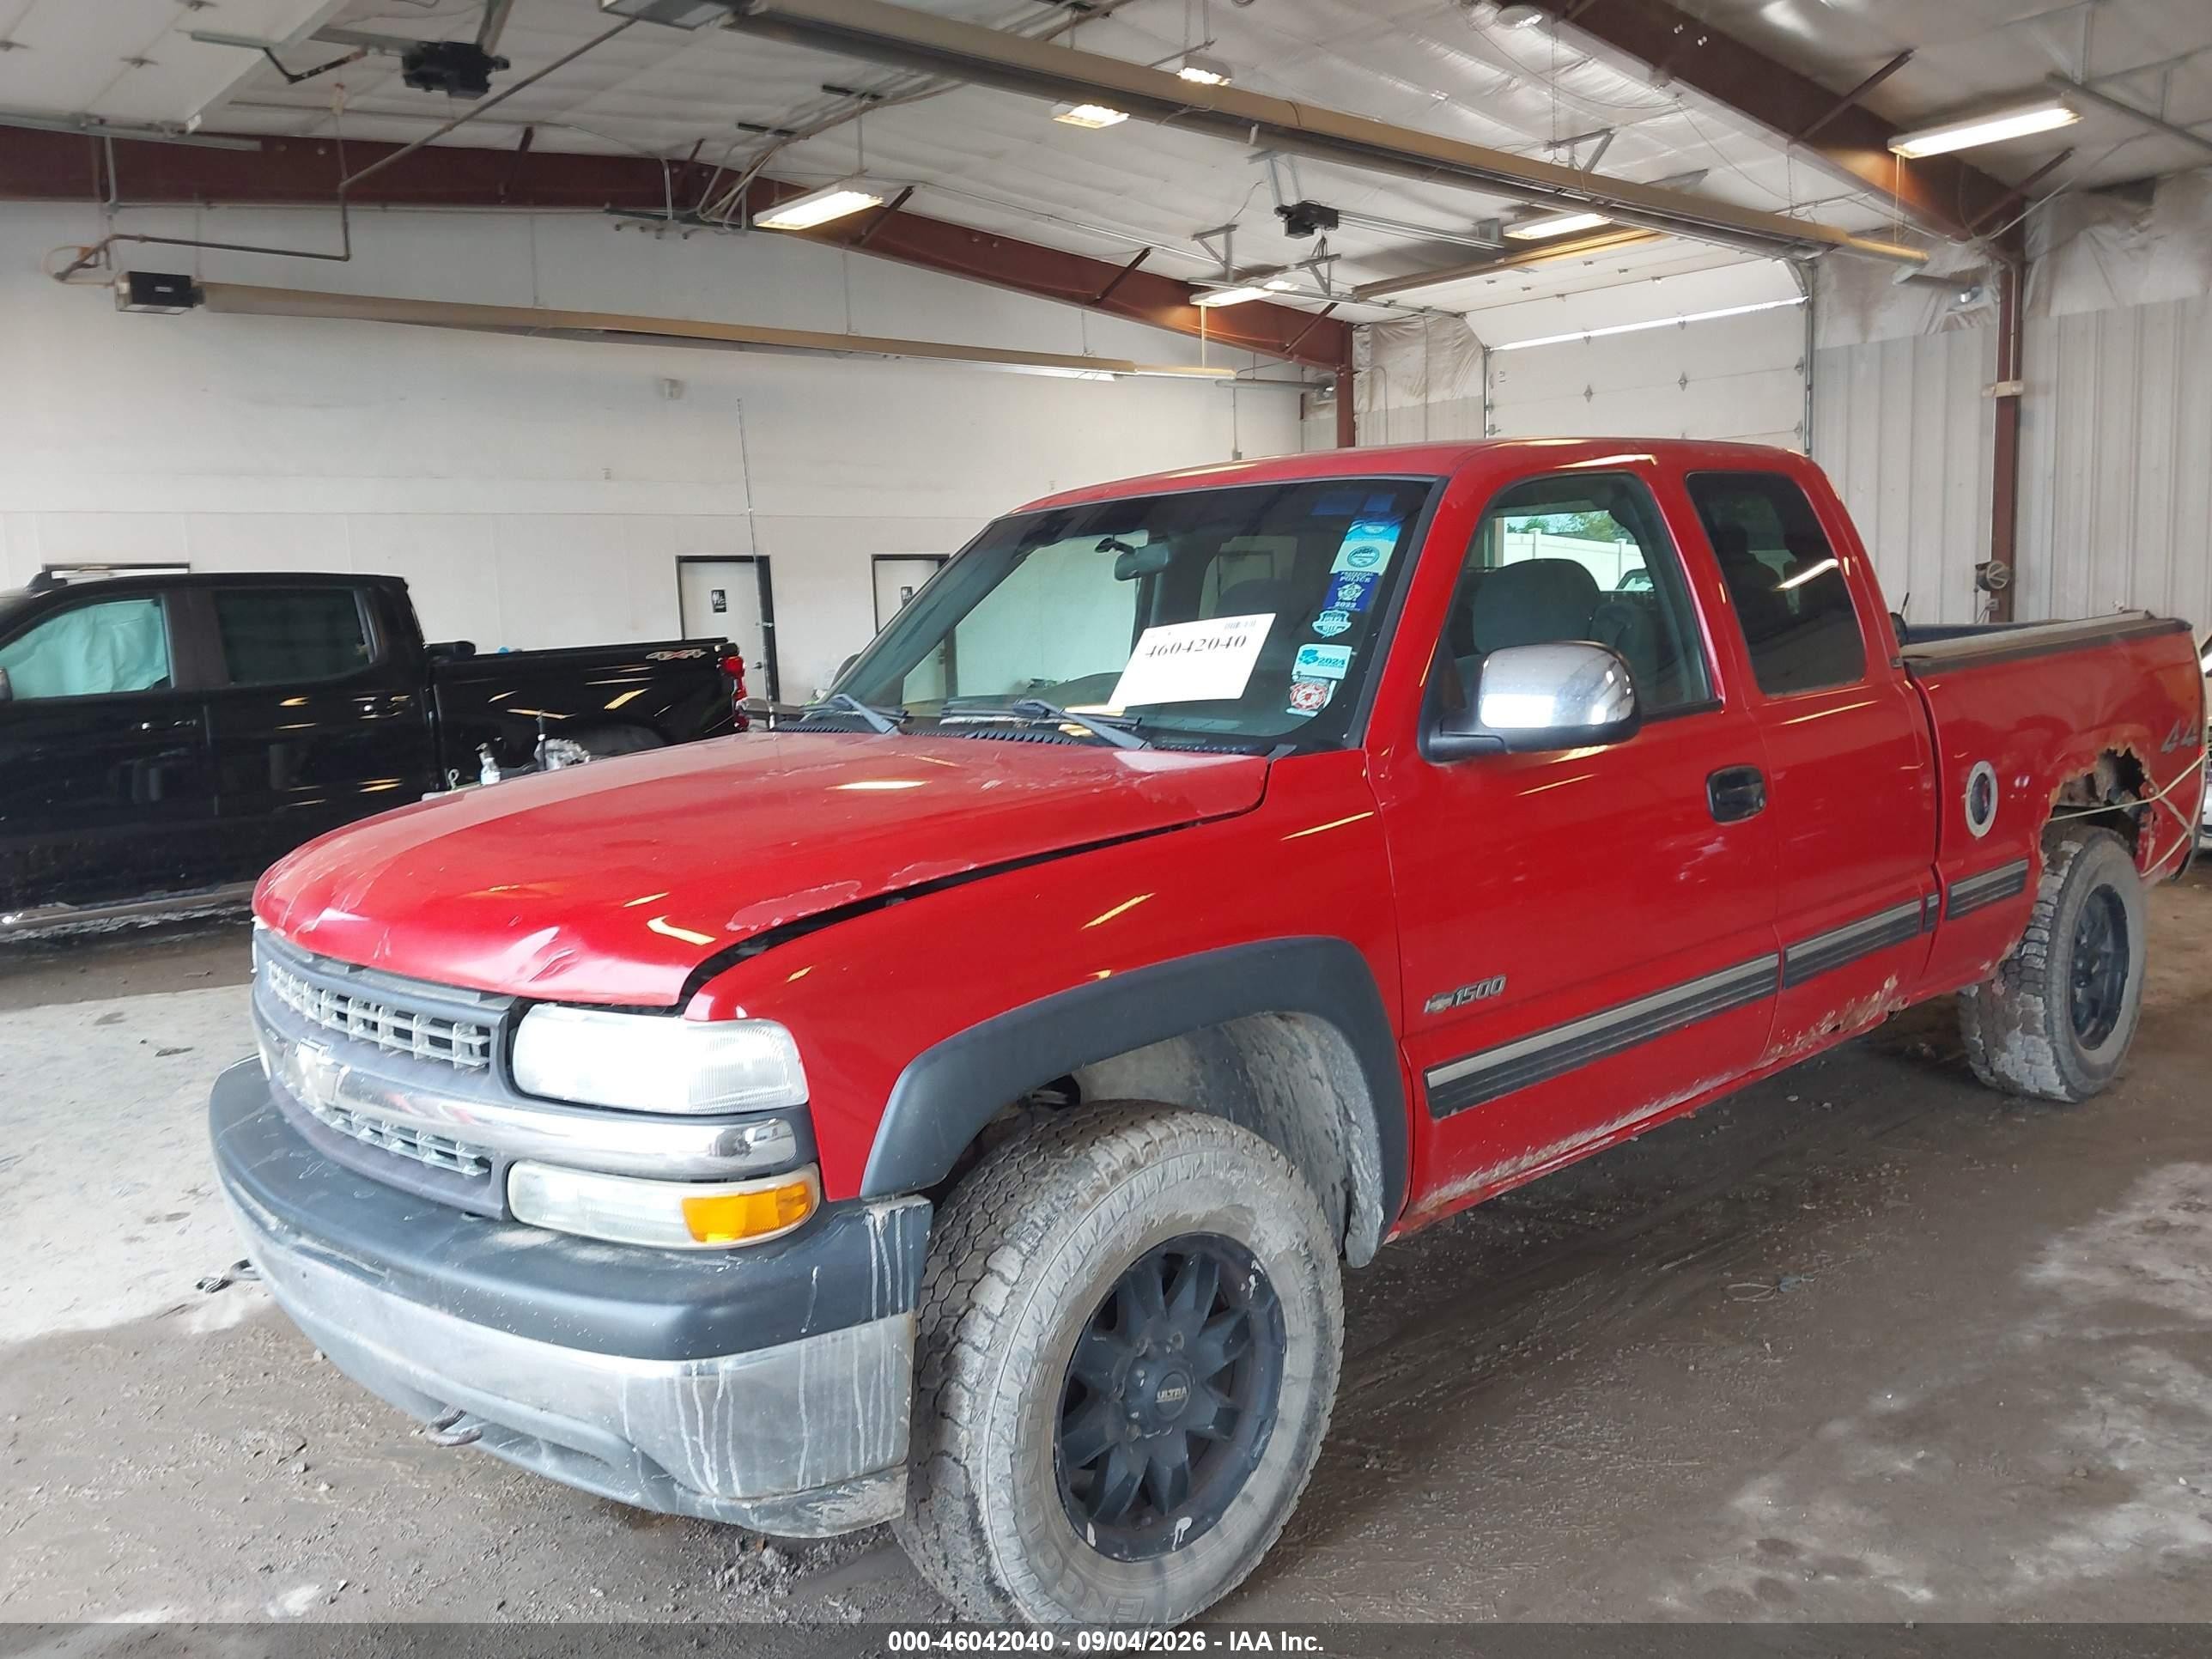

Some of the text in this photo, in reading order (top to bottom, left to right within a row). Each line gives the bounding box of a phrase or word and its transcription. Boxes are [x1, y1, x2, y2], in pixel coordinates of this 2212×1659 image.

[1146, 635, 1248, 659] 46042040
[1454, 974, 1507, 1007] 1500
[1157, 1386, 1188, 1401] ULTRA
